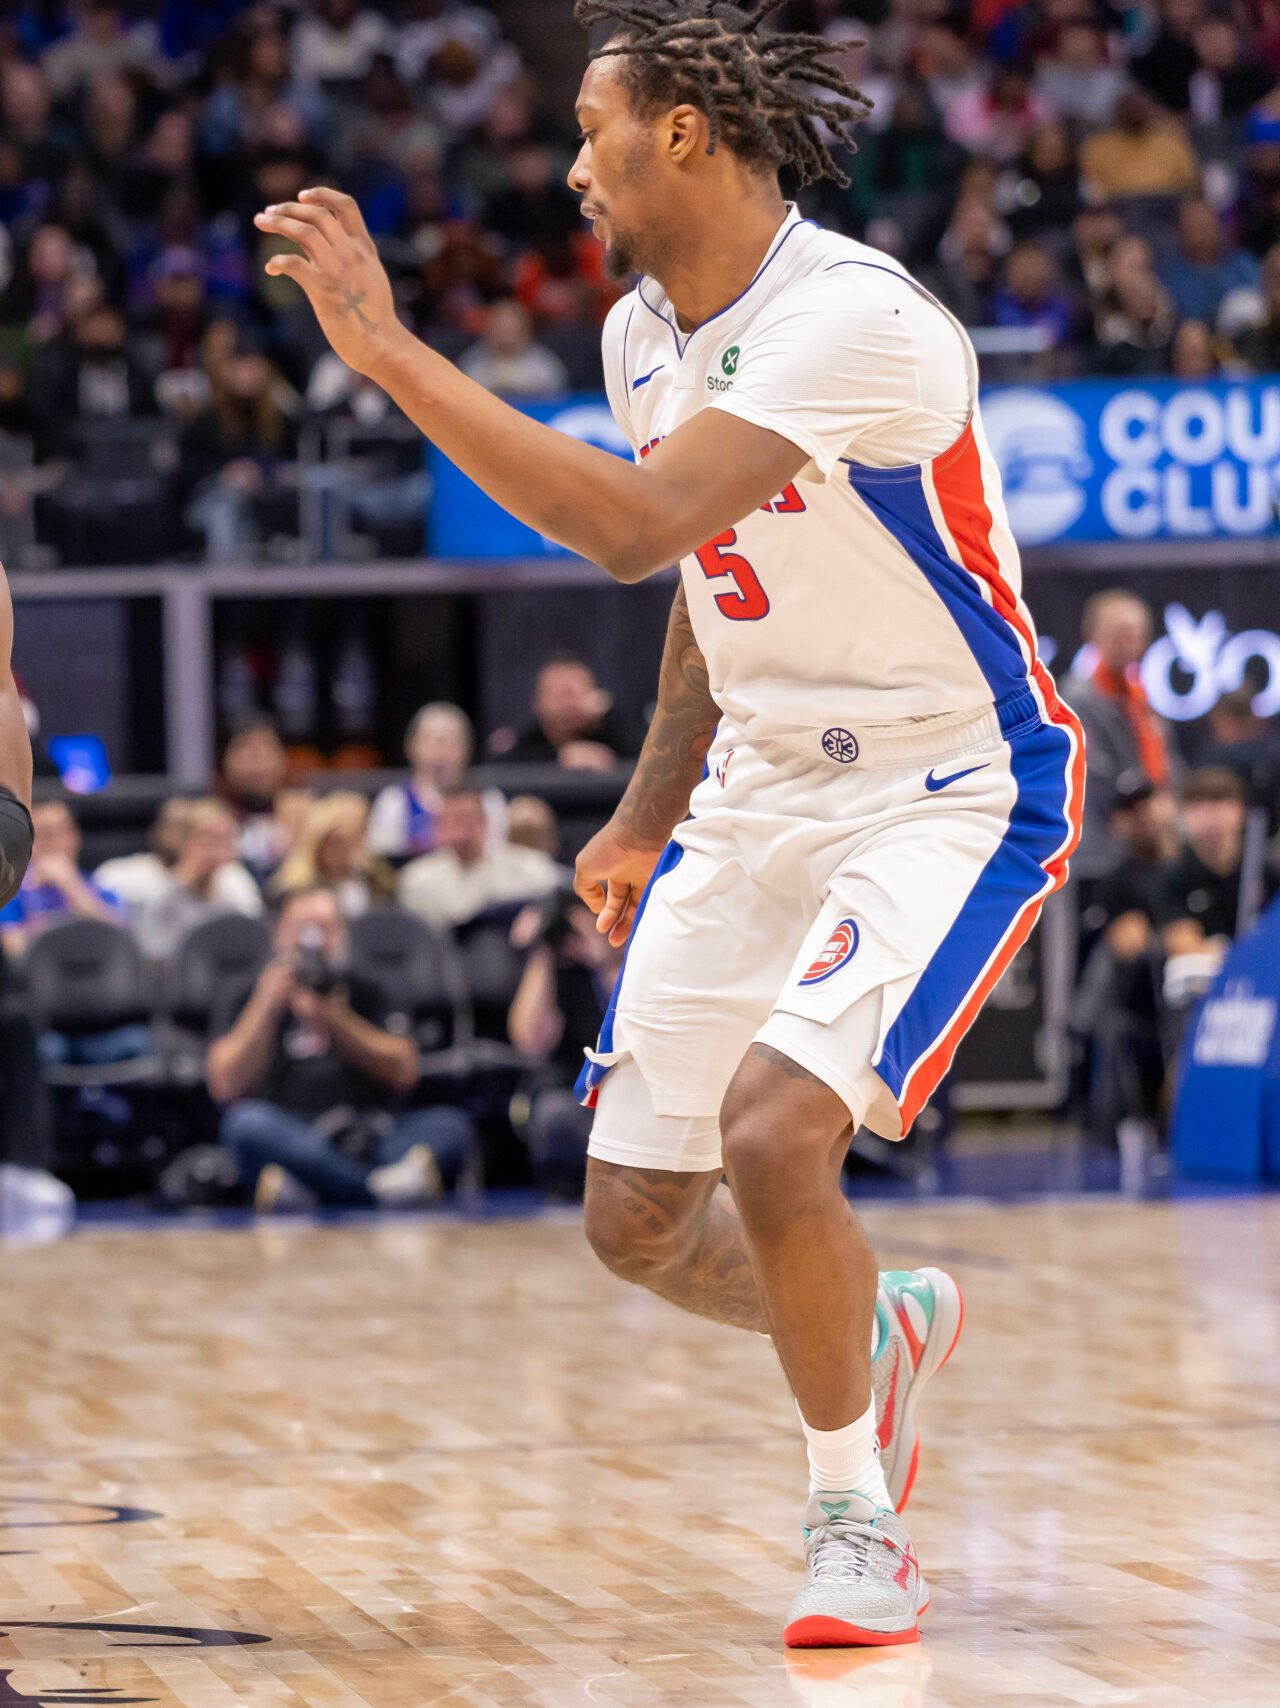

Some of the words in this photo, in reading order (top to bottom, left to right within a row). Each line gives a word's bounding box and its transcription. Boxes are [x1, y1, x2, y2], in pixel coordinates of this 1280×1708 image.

[1099, 387, 1280, 466] COU
[1099, 461, 1280, 538] CLU
[694, 527, 770, 621] 5
